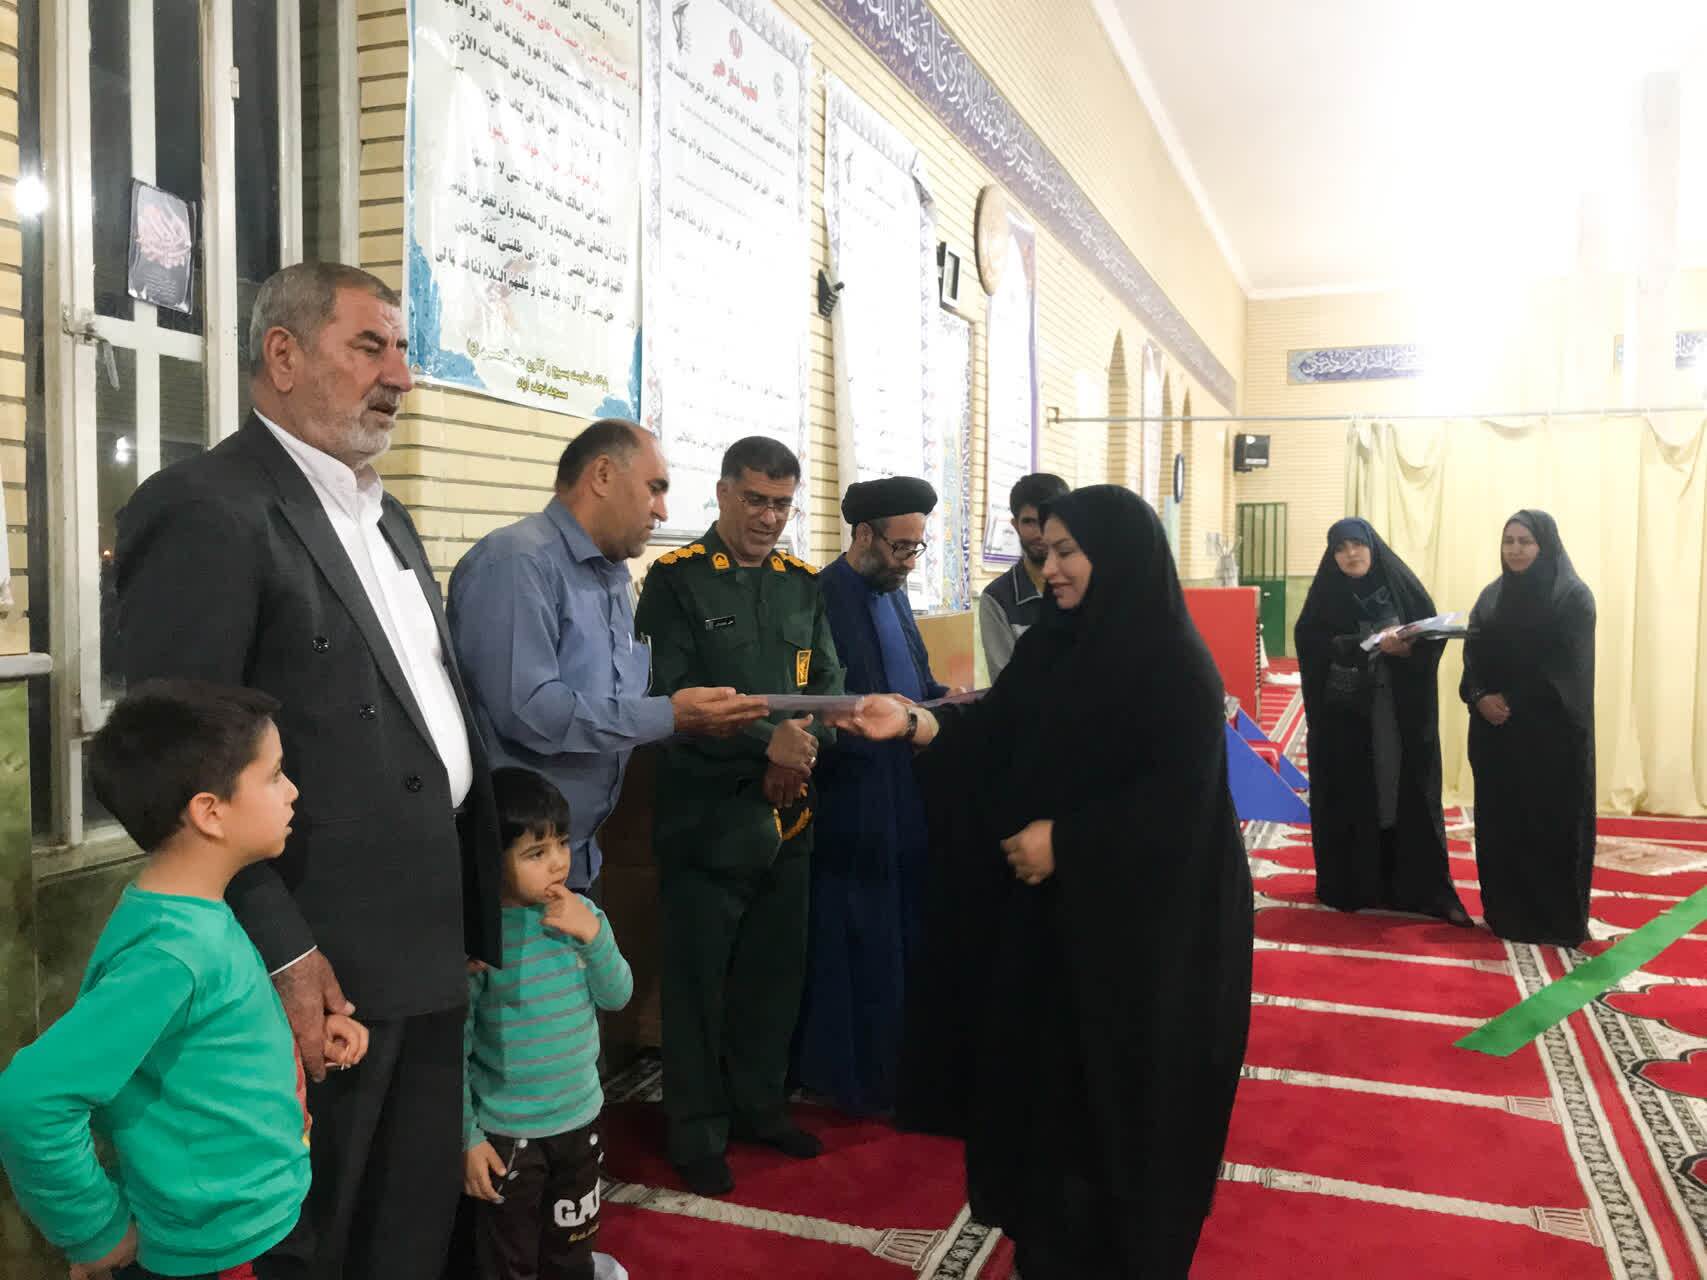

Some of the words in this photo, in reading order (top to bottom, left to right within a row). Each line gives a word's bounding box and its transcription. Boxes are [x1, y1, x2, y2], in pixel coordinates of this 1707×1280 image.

[515, 207, 536, 224] محمد
[550, 364, 571, 382] بسیج
[545, 383, 568, 400] مسجد
